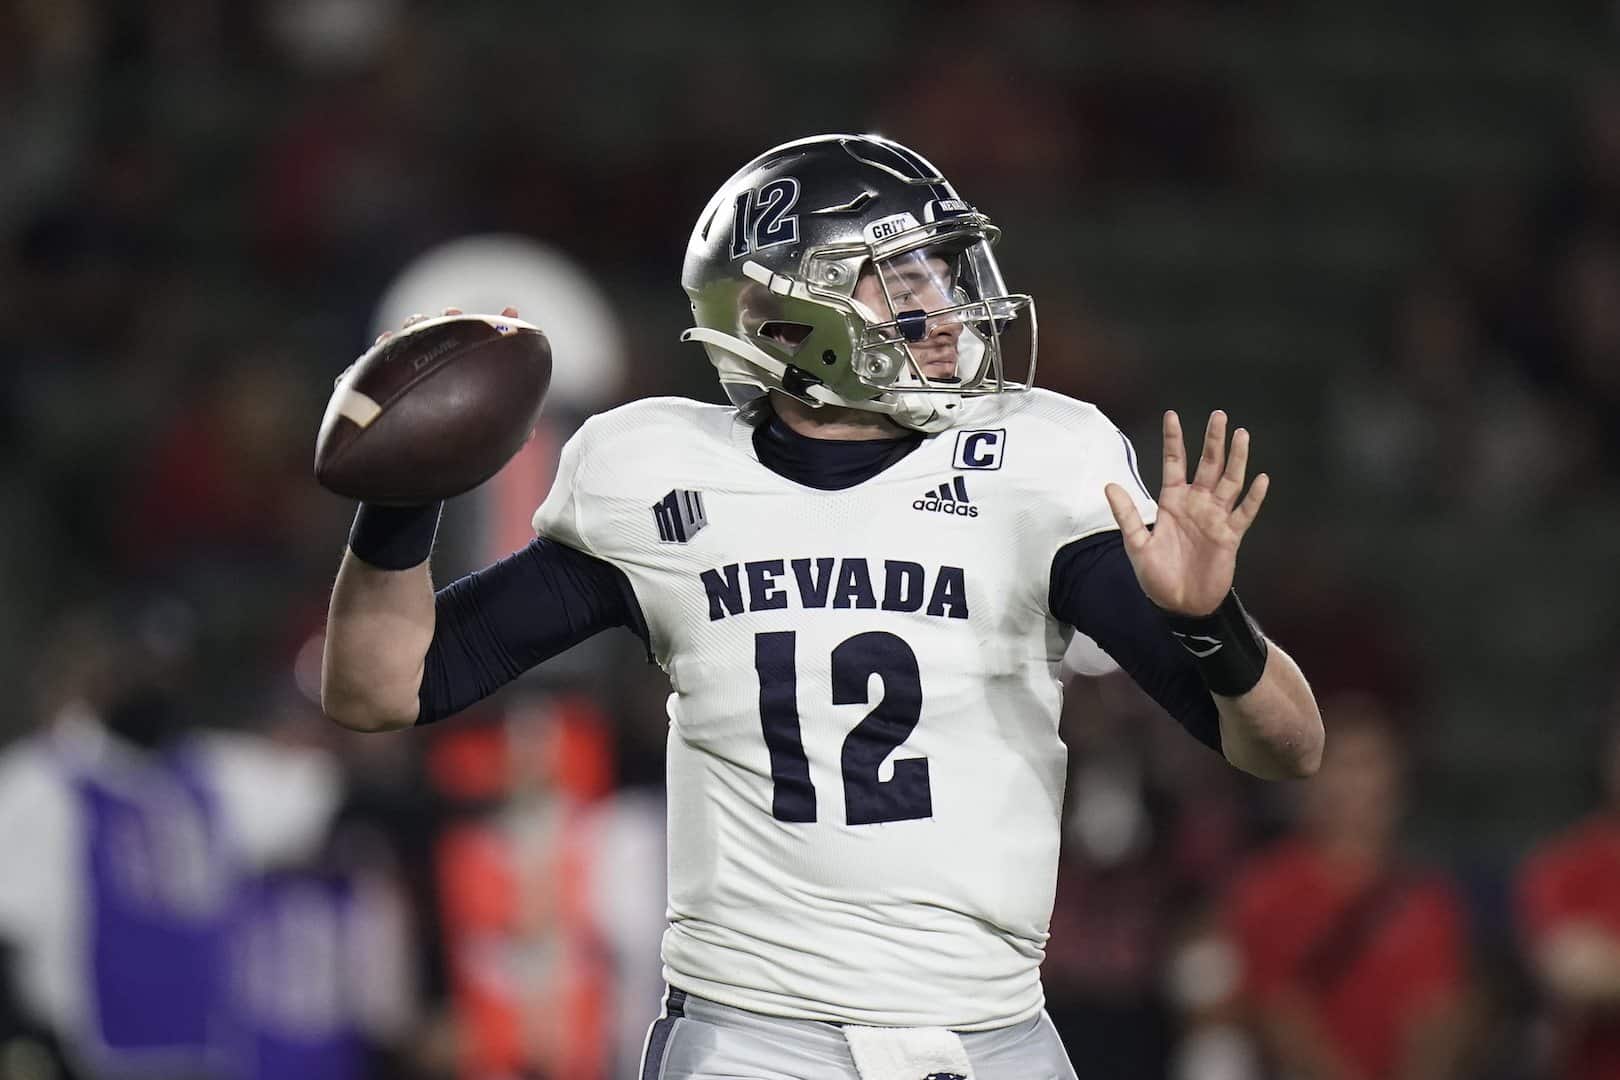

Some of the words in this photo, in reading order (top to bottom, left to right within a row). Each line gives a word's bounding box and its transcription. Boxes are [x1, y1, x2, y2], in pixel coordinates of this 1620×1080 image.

[731, 178, 801, 261] 12
[873, 217, 906, 239] GRIT
[963, 432, 997, 467] C
[913, 498, 979, 518] adidas
[700, 557, 969, 622] NEVADA
[755, 630, 933, 826] 12
